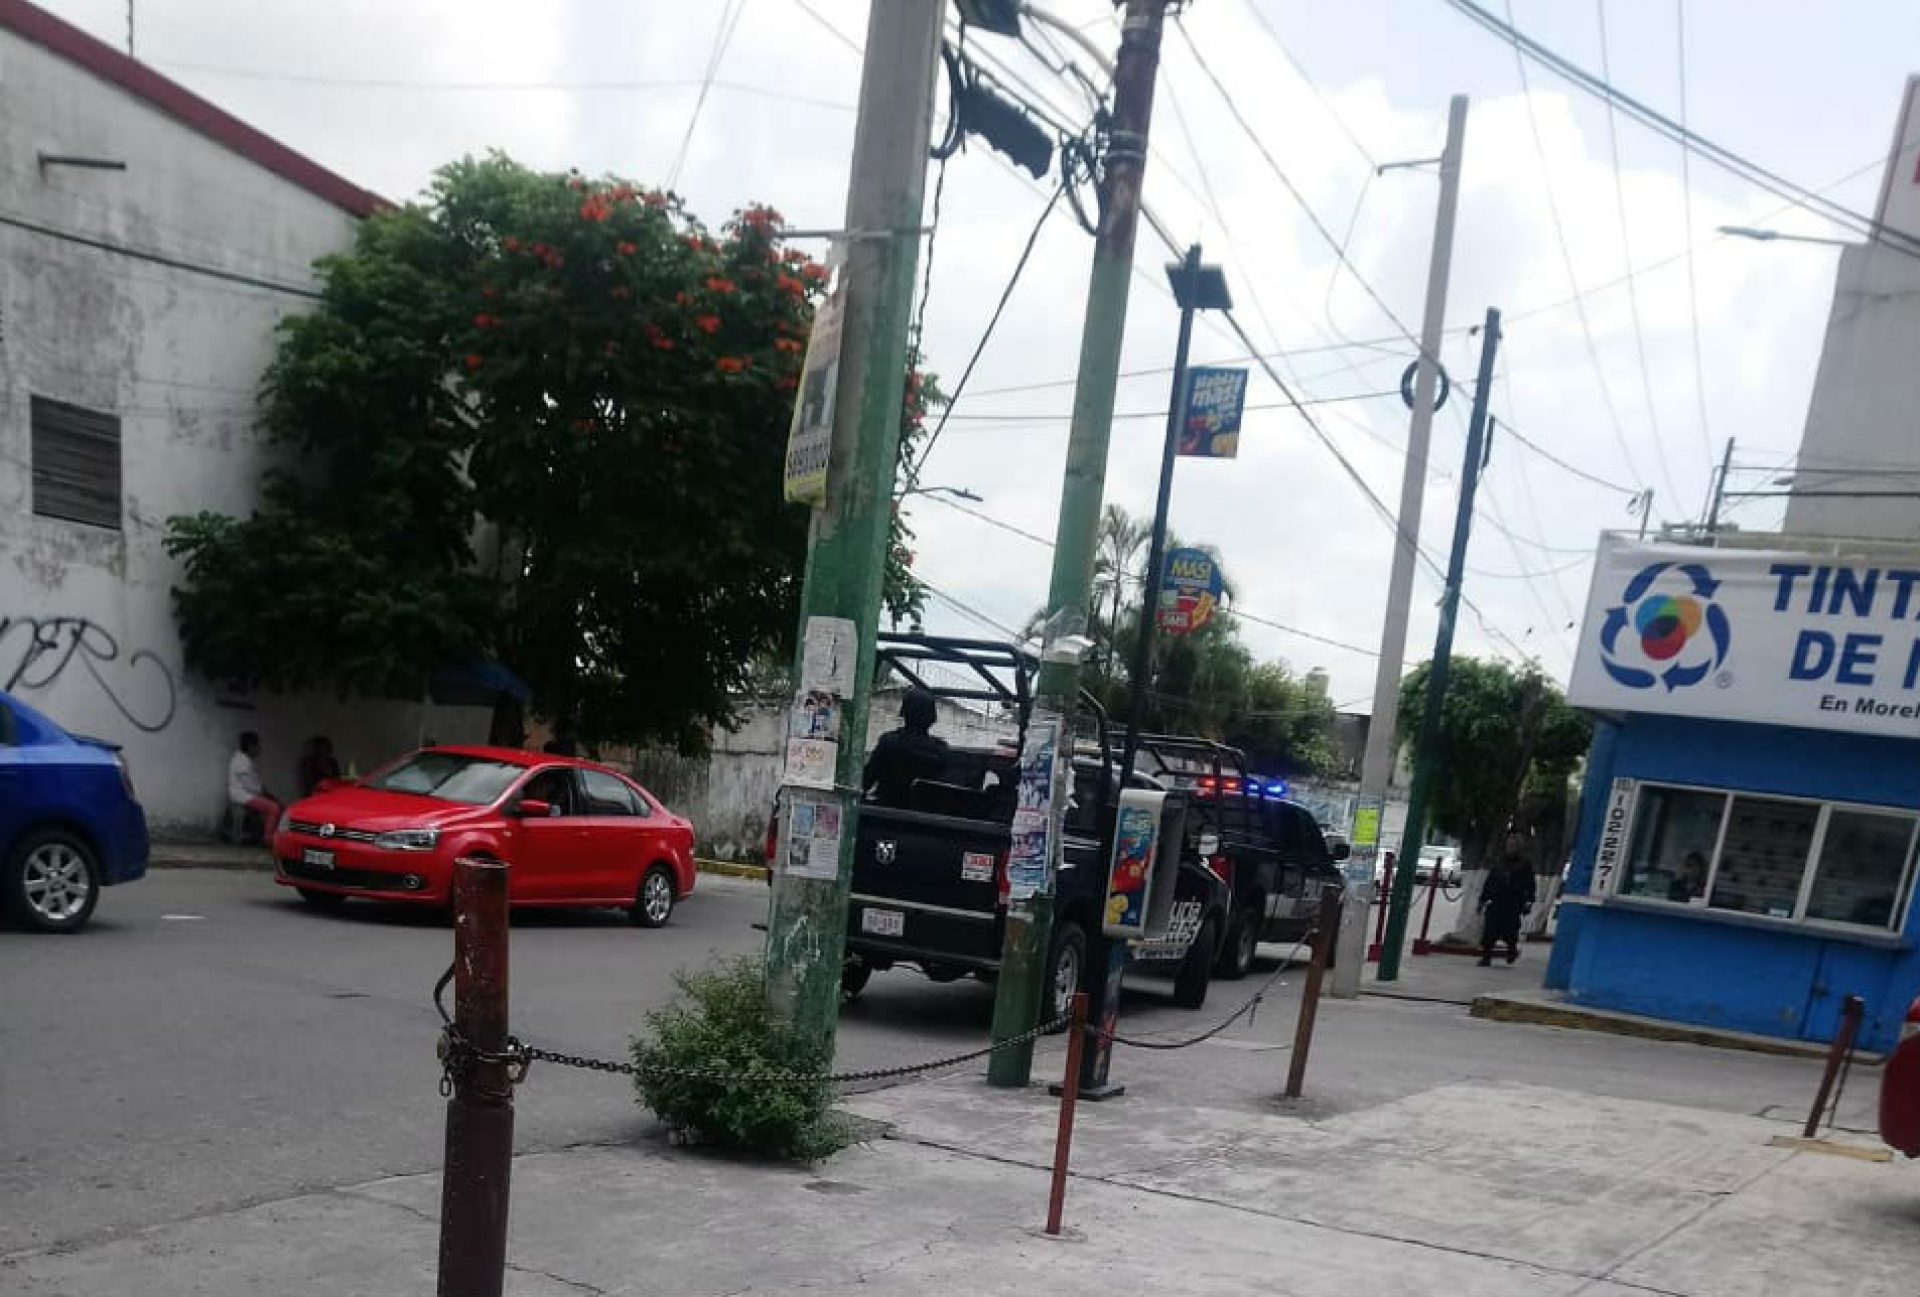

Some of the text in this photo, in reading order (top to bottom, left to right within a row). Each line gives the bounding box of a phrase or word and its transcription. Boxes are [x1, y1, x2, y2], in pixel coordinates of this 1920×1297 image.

[1770, 563, 1920, 621] TINT
[1788, 629, 1884, 686] DE
[1820, 694, 1849, 713] En
